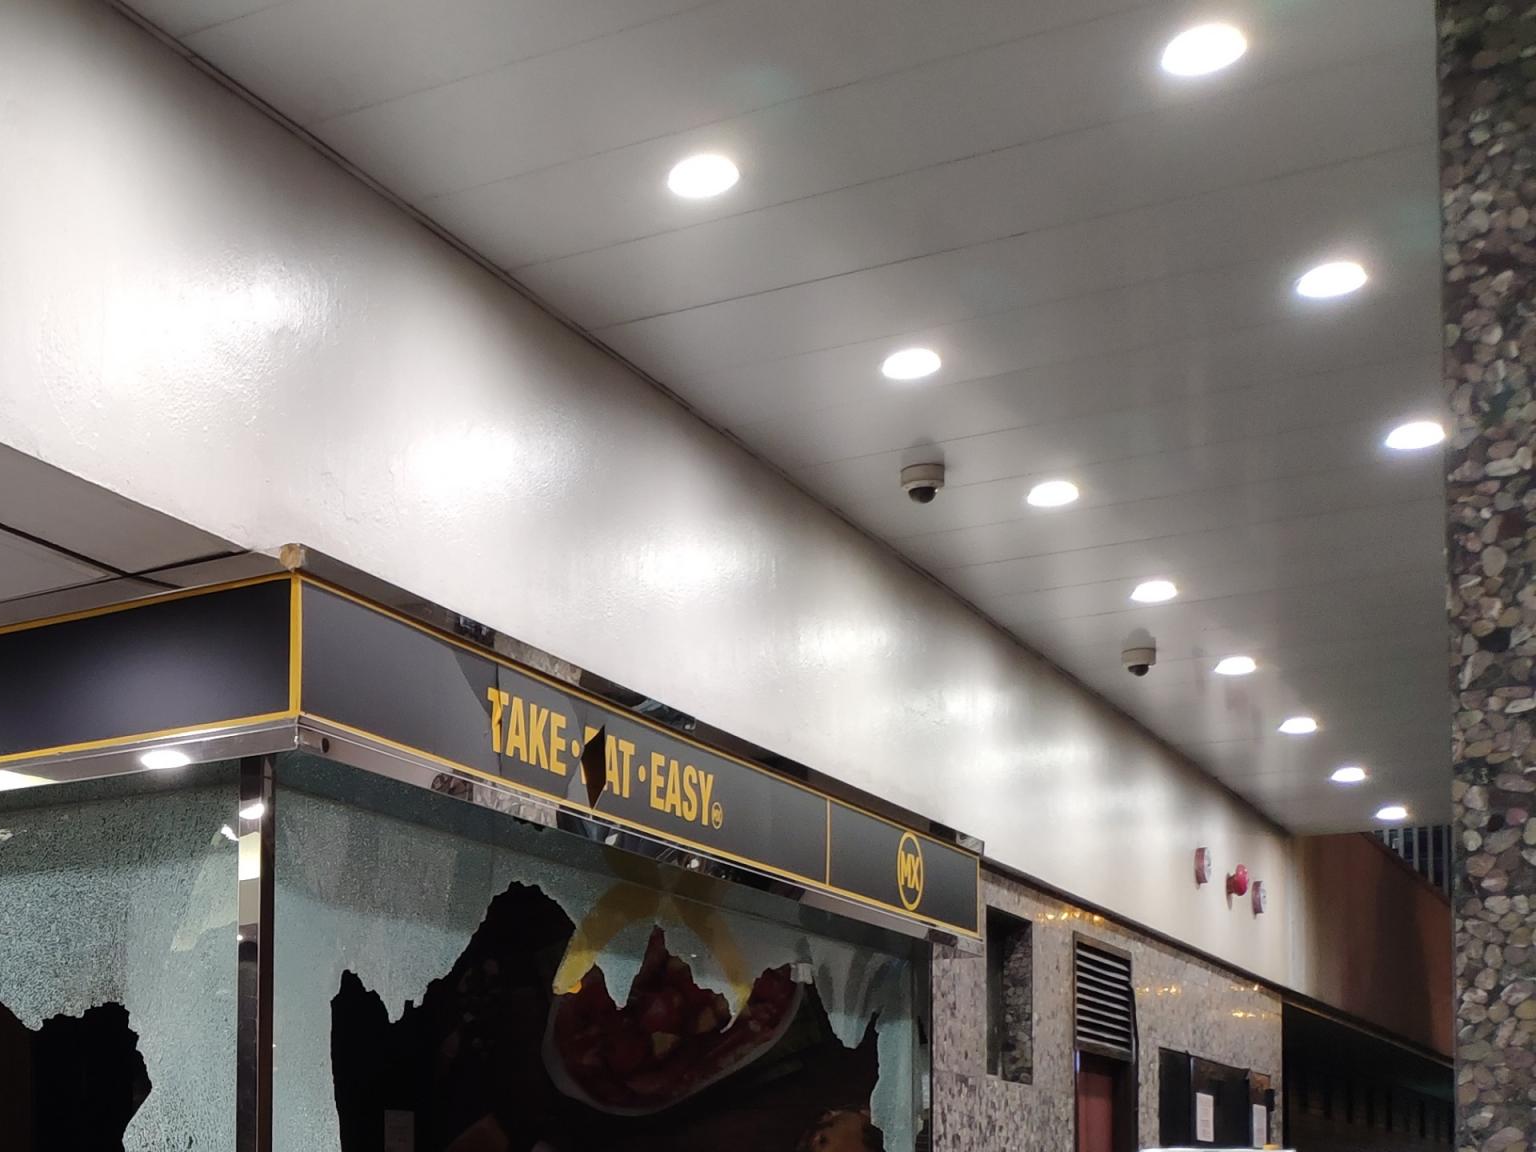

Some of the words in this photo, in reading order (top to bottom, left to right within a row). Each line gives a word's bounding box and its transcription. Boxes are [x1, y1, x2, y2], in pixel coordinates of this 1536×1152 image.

[487, 687, 567, 777] TAKE
[580, 726, 635, 798] AT
[650, 751, 714, 826] EASY
